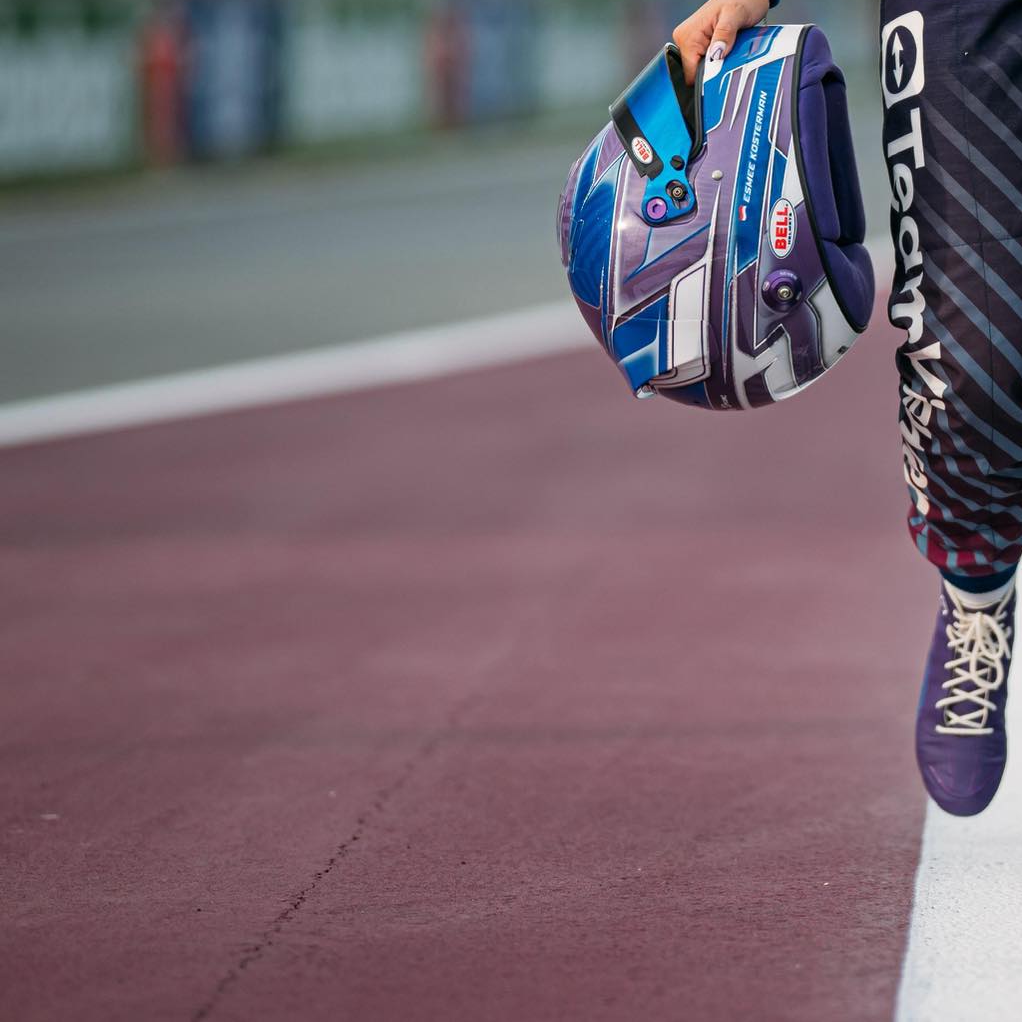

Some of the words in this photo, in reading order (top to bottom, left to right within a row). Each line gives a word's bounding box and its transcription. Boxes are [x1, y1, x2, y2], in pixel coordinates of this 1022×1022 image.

[749, 90, 768, 161] KOSTERMAN
[743, 162, 756, 203] ESMEE
[775, 207, 788, 249] BELL
